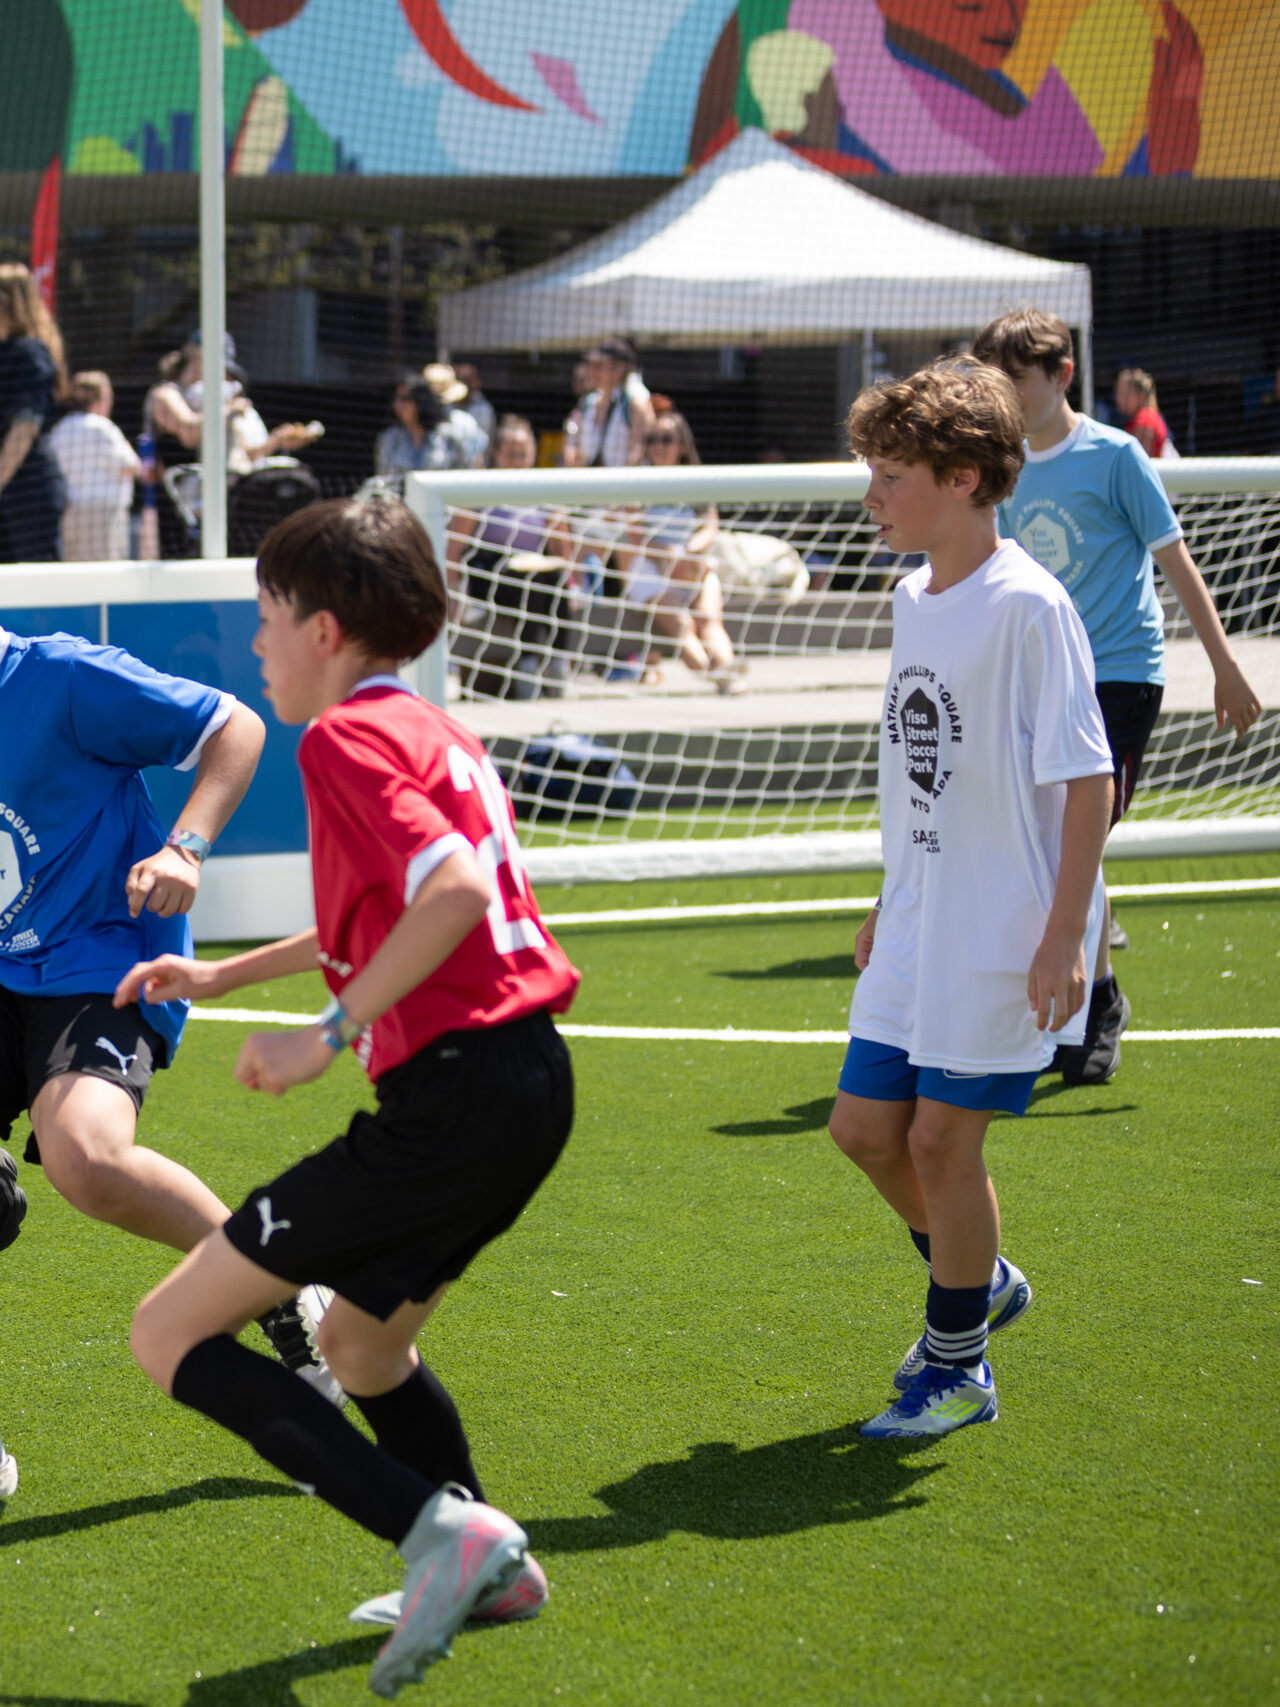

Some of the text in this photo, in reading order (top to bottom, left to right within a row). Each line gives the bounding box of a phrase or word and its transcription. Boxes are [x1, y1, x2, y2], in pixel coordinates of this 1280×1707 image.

[887, 682, 901, 744] NATHAN
[898, 665, 936, 684] PHILLIPS
[905, 709, 928, 725] Visa
[906, 726, 938, 741] Street
[907, 743, 937, 757] Socce
[907, 759, 934, 774] Park
